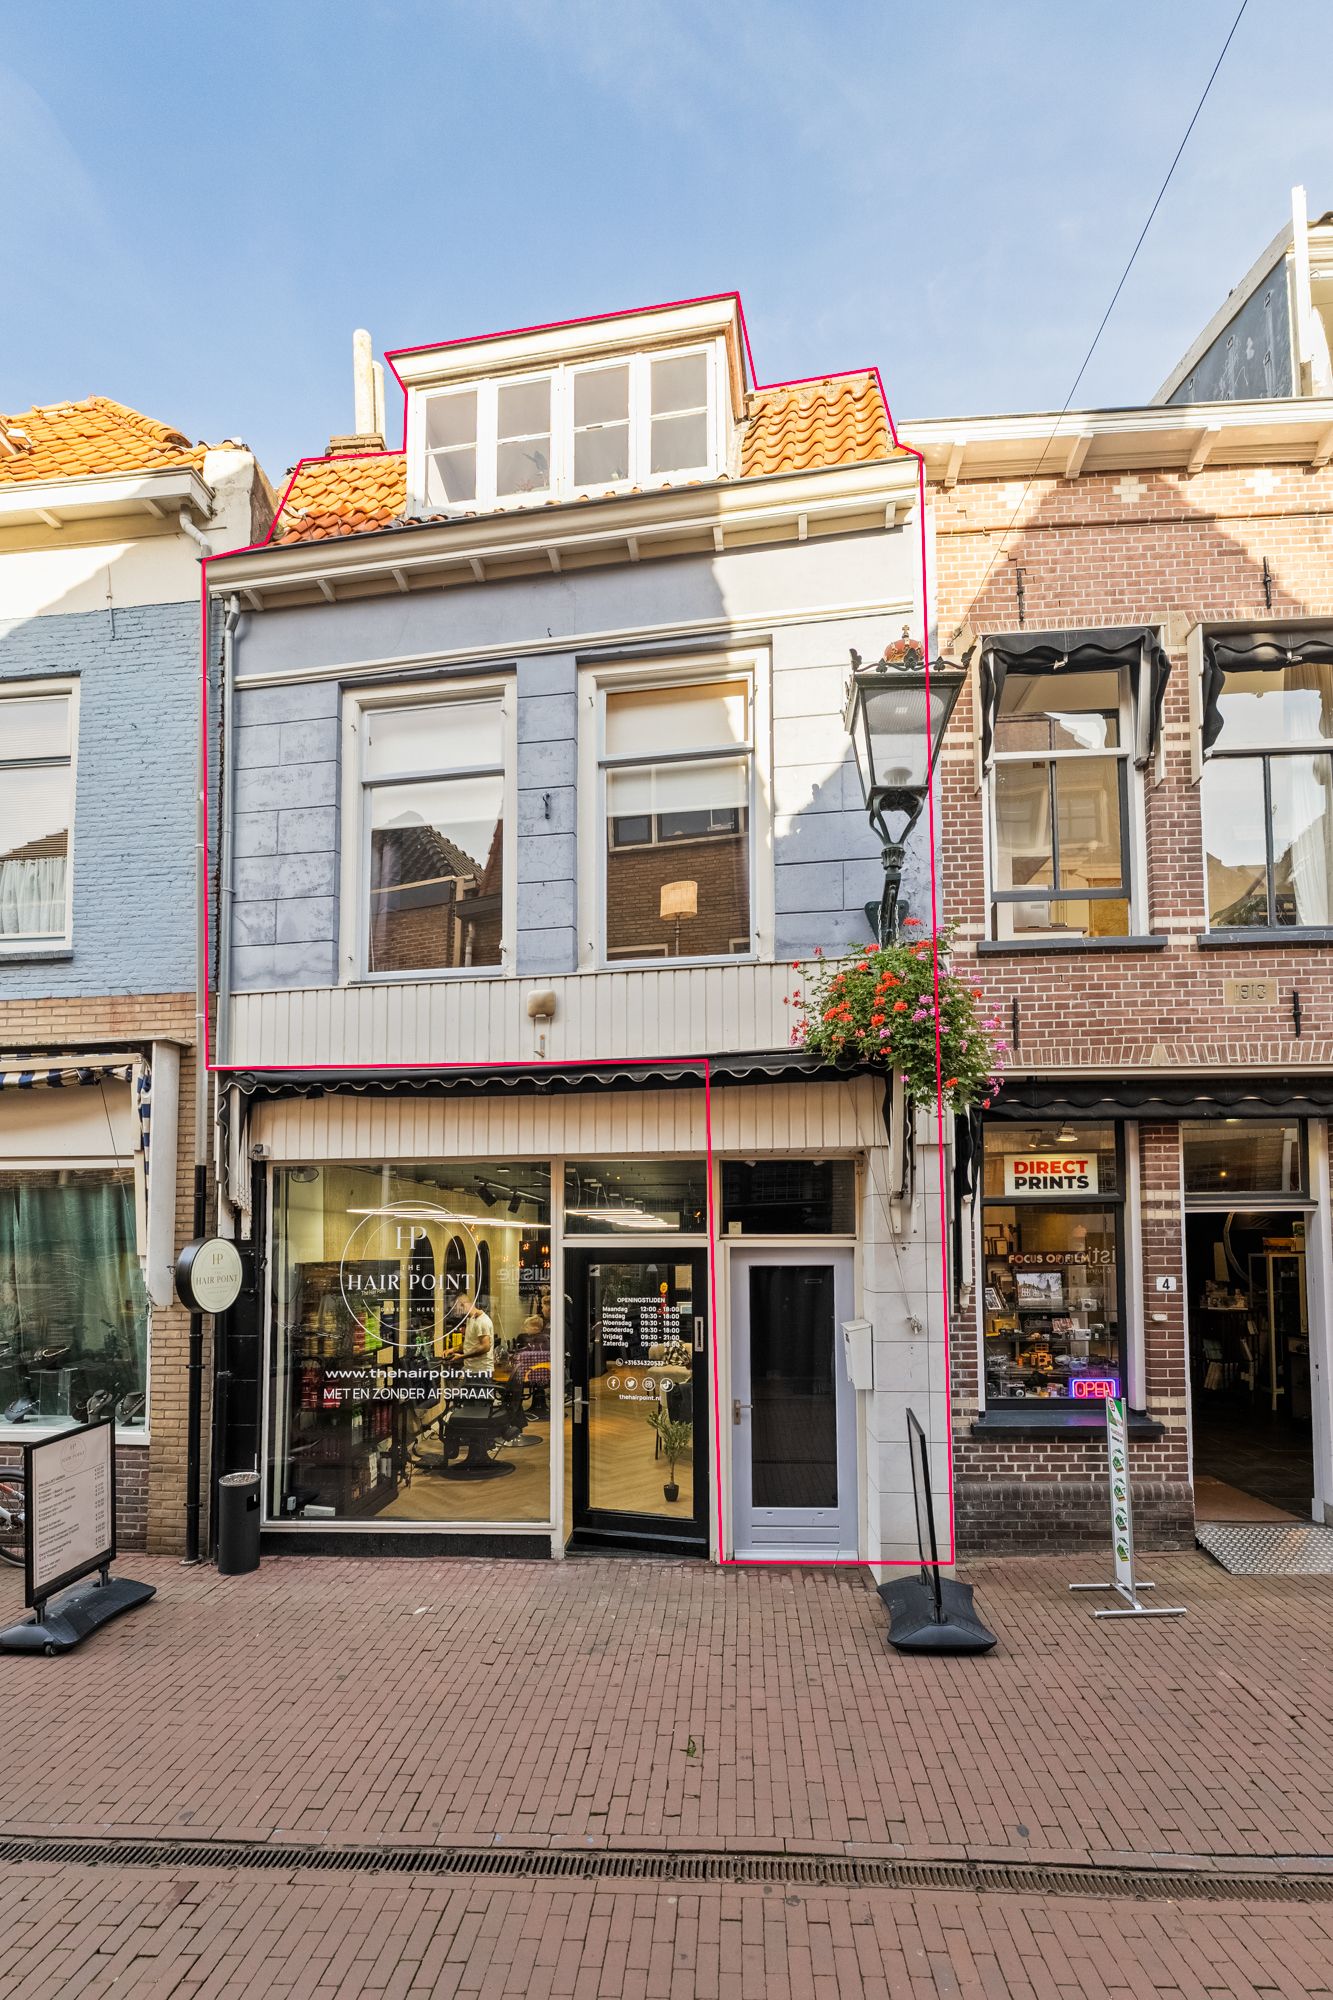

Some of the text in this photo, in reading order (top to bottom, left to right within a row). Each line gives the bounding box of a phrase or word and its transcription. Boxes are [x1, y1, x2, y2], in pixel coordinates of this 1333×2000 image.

[1235, 984, 1267, 1000] 1913
[1013, 1160, 1089, 1175] DIRECT
[1014, 1175, 1090, 1190] PRINTS
[395, 1226, 427, 1250] HP
[1008, 1254, 1043, 1264] FOCUS
[195, 1274, 238, 1286] HAIR POINT
[347, 1273, 474, 1291] HAIR POINT
[1162, 1278, 1170, 1290] 4
[325, 1368, 493, 1380] www.thehairpoint.nl
[323, 1388, 496, 1400] MET EN ZONDER AFSPRAAK
[1075, 1381, 1114, 1398] OPEN
